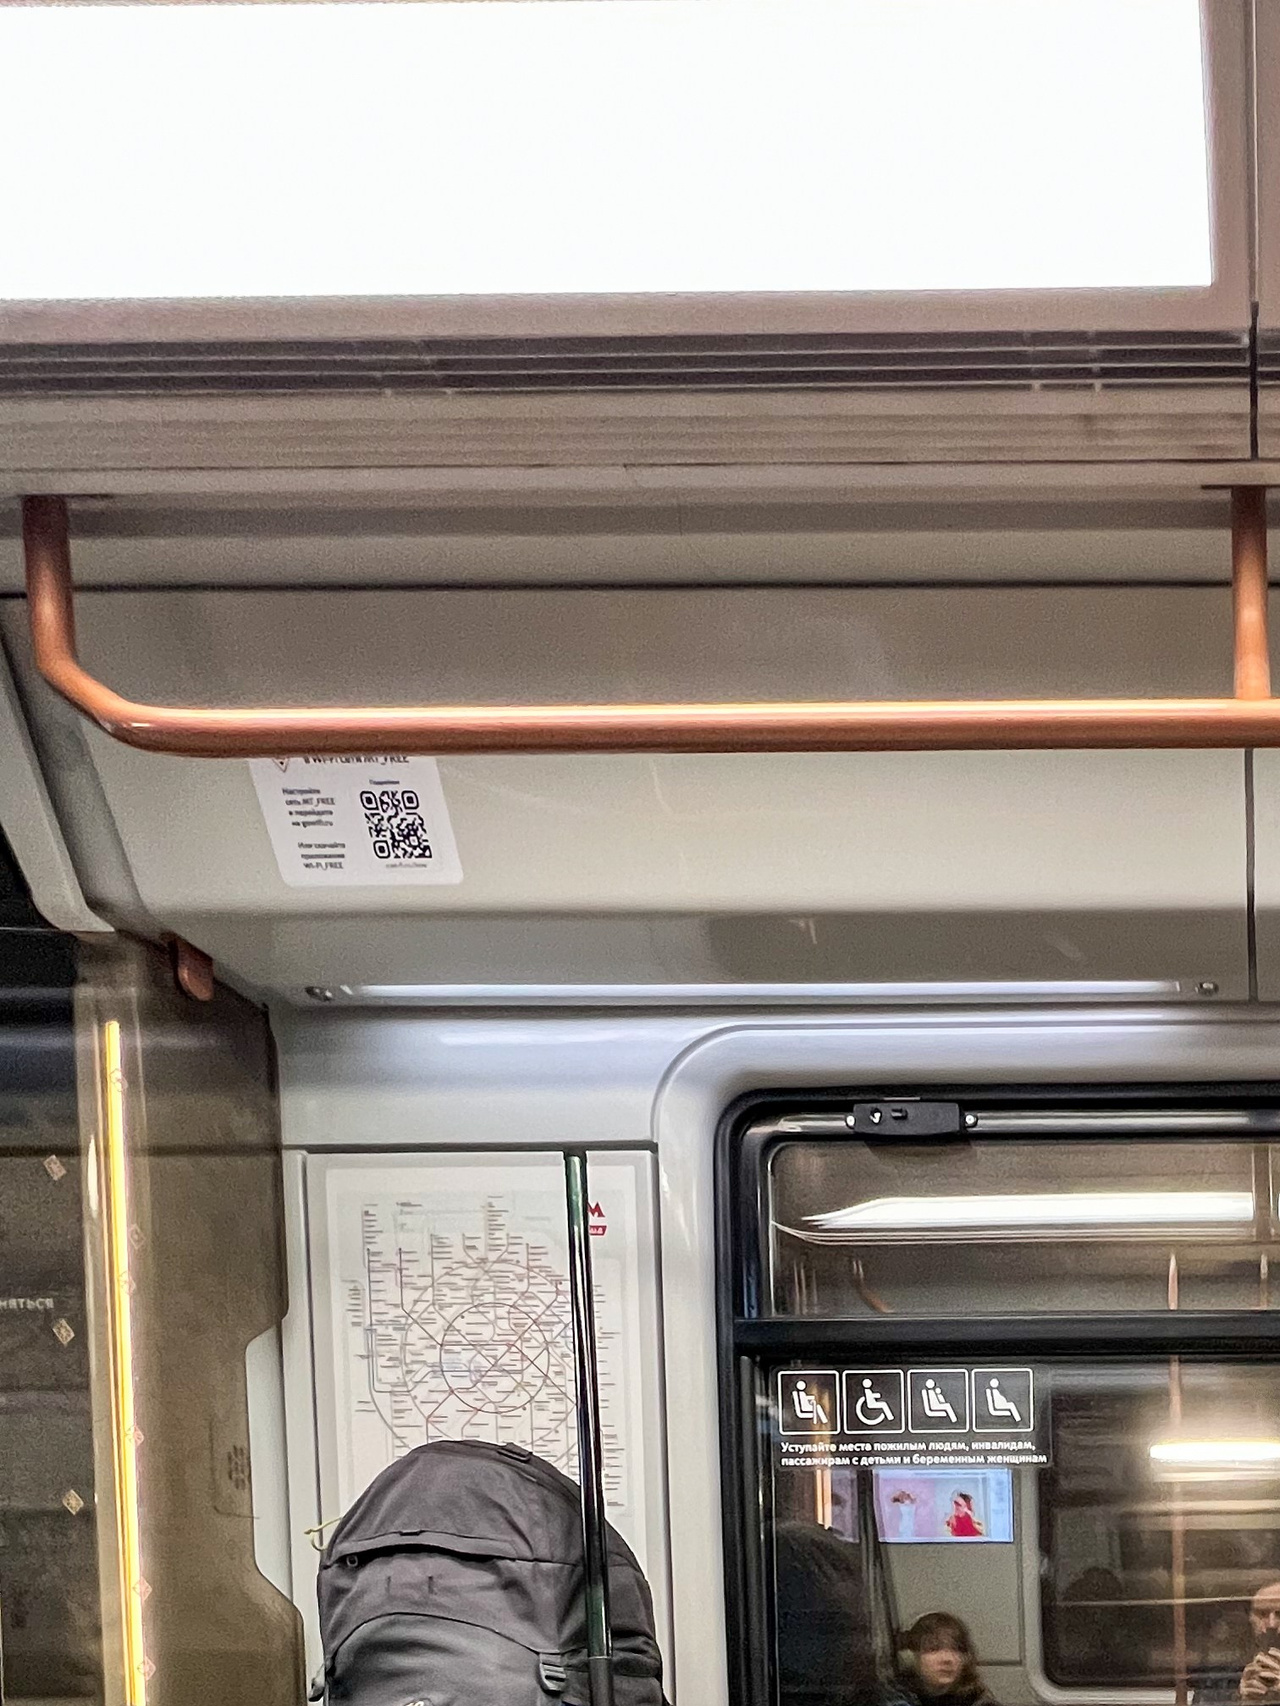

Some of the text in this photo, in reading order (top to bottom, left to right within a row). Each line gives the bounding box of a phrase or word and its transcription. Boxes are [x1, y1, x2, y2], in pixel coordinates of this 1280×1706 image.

[781, 1440, 1036, 1455] Уступайте места пожилым людям, инвалидам,
[781, 1453, 1048, 1467] пассажирам с детьми и беременным женщинам
